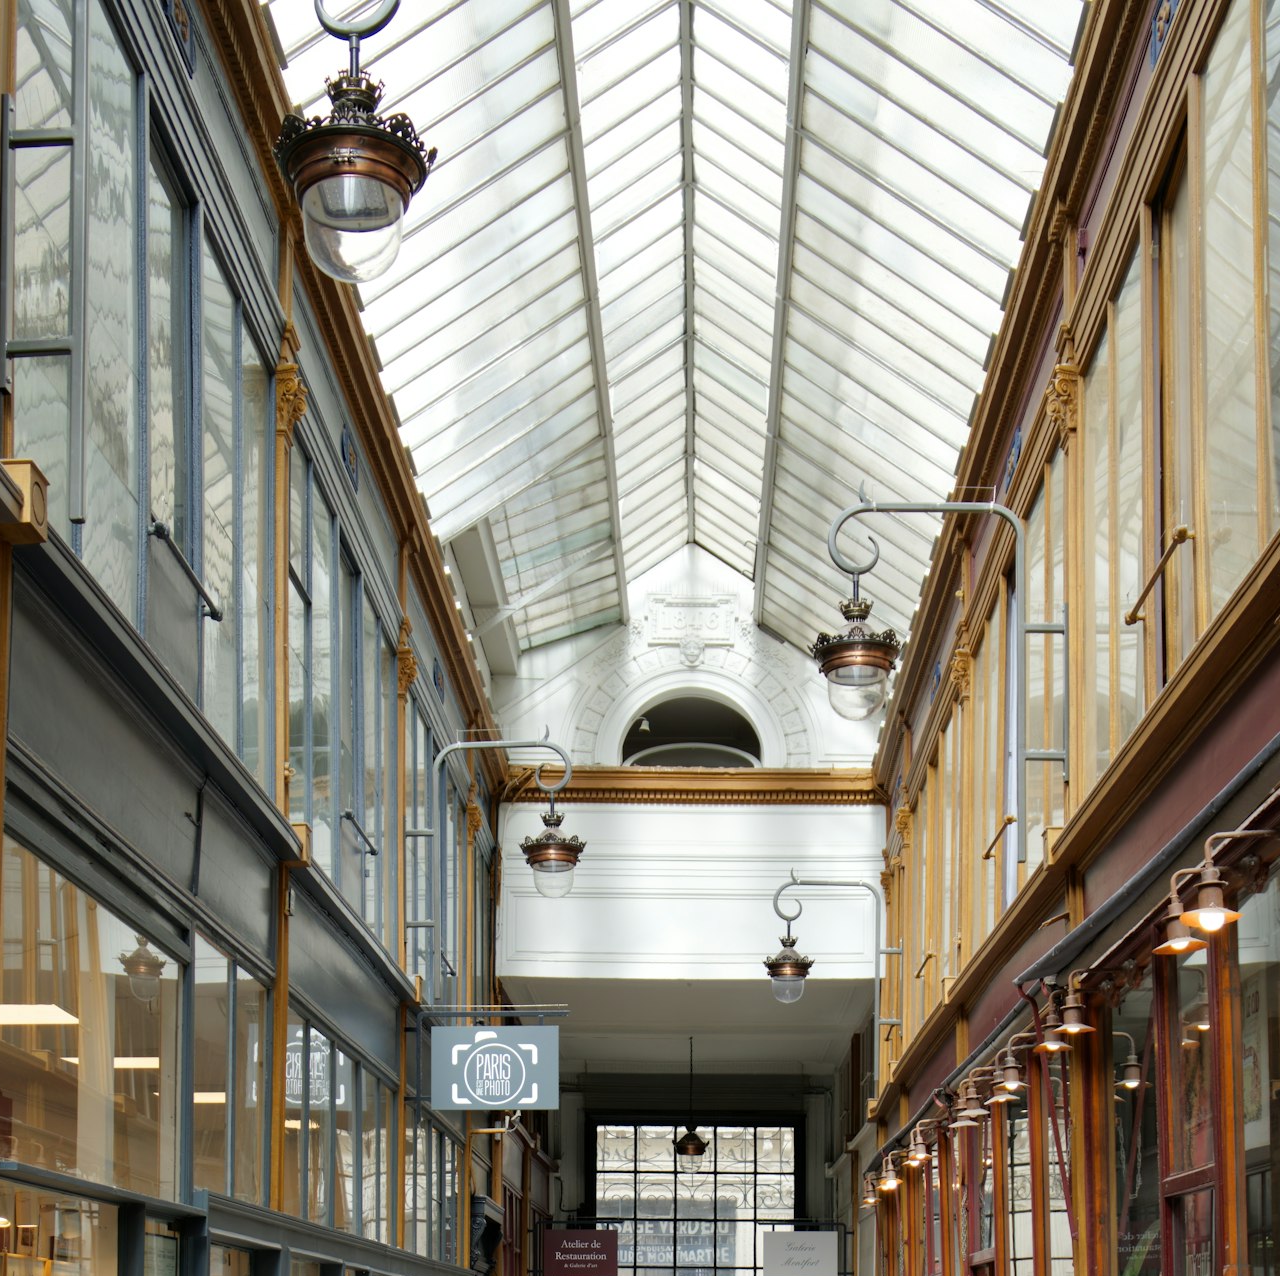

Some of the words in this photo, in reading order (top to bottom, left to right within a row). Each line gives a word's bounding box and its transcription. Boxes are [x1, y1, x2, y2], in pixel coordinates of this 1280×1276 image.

[476, 1053, 511, 1080] PARIS
[484, 1080, 511, 1096] PHOTO
[660, 1221, 729, 1234] VERDEAU
[561, 1239, 589, 1249] Atelier
[590, 1239, 601, 1249] de
[555, 1251, 607, 1260] Restauration
[648, 1247, 730, 1263] MONTMARTRE
